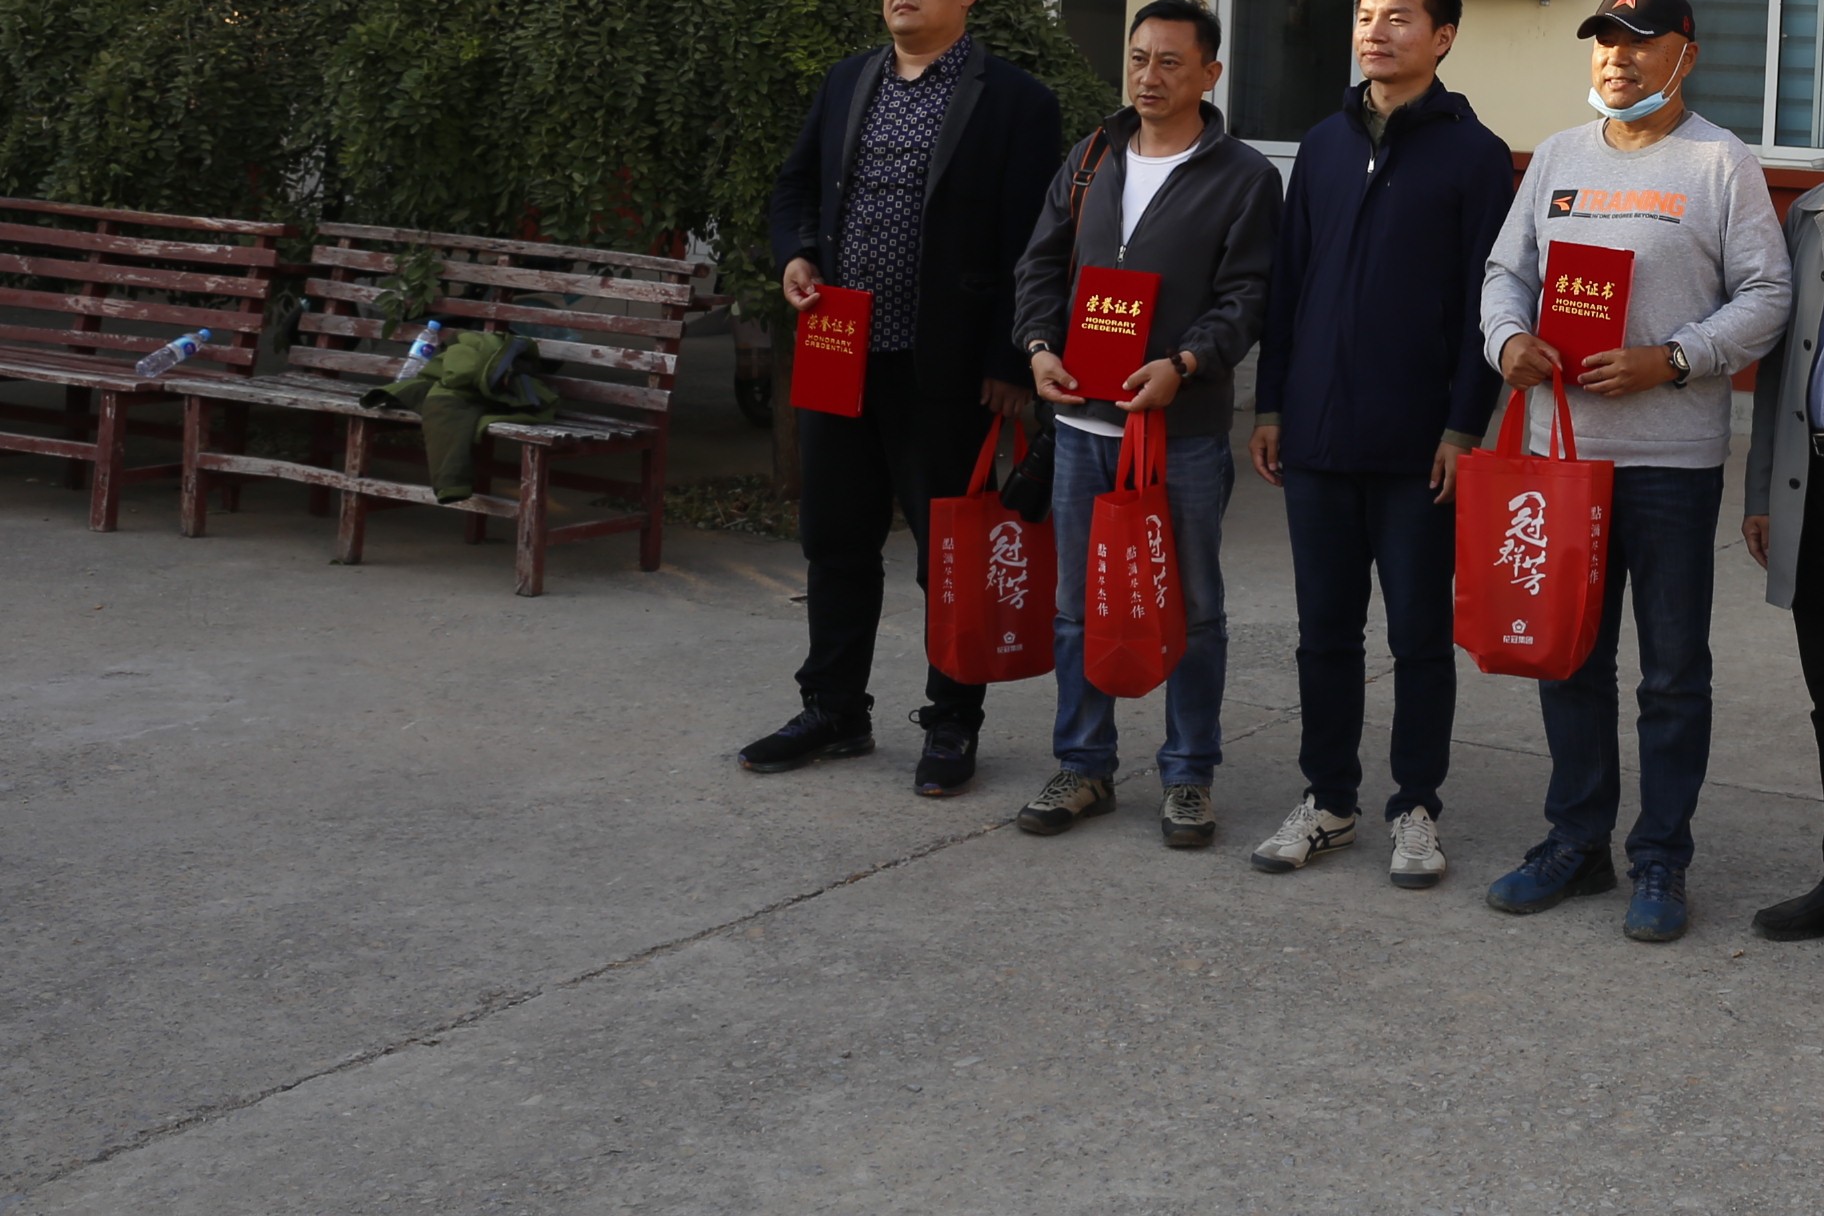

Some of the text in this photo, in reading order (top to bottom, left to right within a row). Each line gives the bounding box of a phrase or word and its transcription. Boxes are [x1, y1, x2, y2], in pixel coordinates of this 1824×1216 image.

[1577, 189, 1687, 217] TRAINING
[1555, 274, 1615, 300] 荣誉证书
[1086, 294, 1143, 317] 荣誉证书
[1551, 305, 1611, 320] CREDENTIAL
[1555, 298, 1609, 312] HONORARY
[807, 313, 856, 336] 荣誉证书
[1081, 323, 1137, 335] CREDENTIAL
[1085, 316, 1136, 329] HONORARY
[804, 339, 853, 354] CREDENTIAL
[807, 334, 852, 347] HONORARY
[1493, 491, 1548, 596] 冠群芳
[984, 521, 1029, 610] 冠群芳
